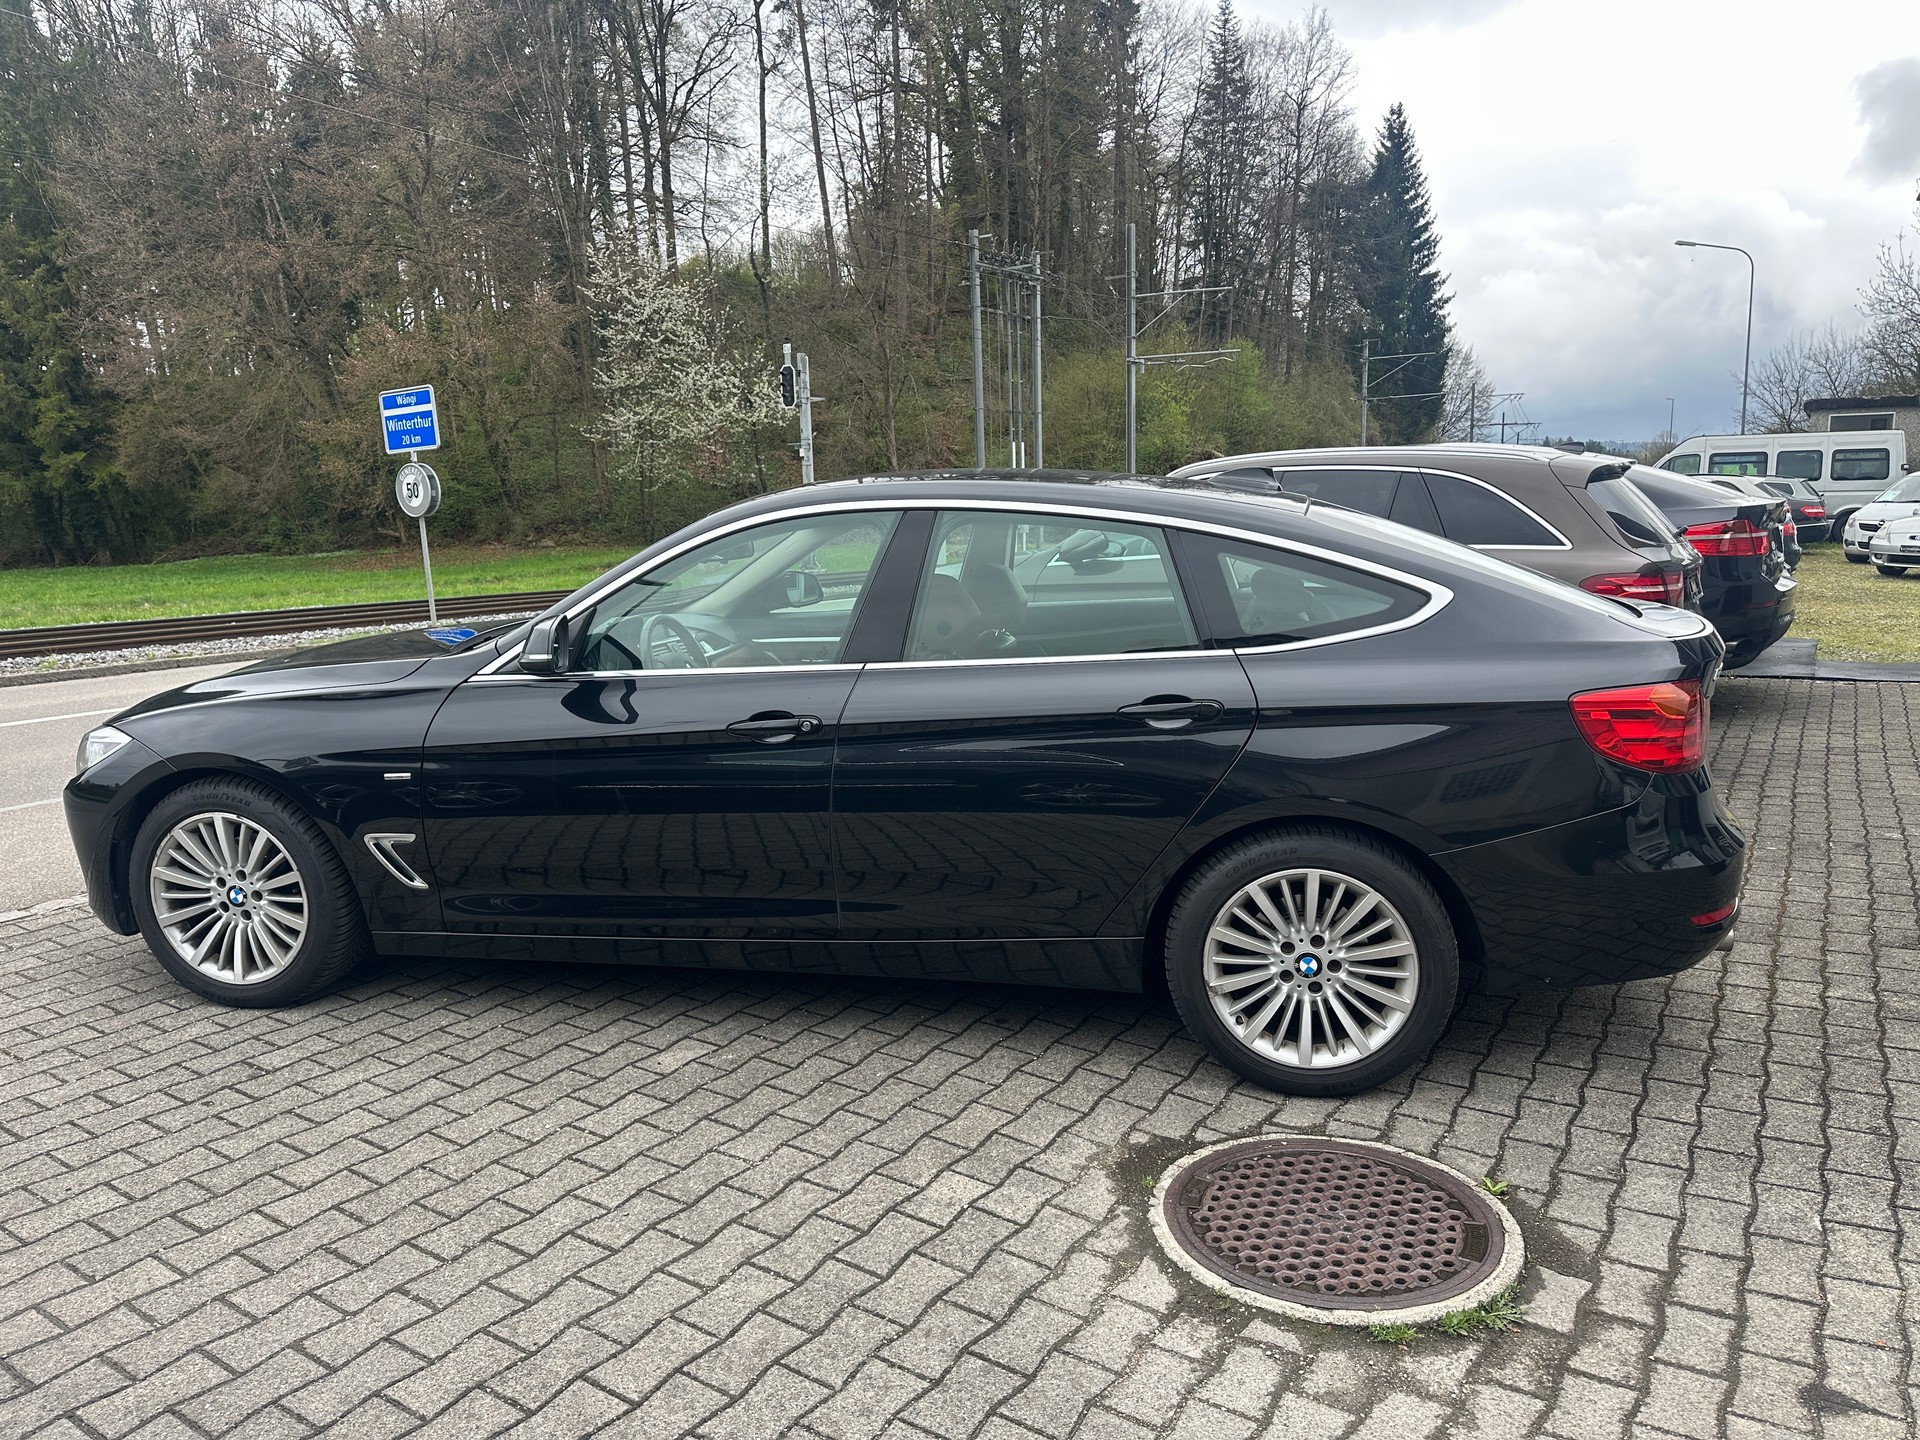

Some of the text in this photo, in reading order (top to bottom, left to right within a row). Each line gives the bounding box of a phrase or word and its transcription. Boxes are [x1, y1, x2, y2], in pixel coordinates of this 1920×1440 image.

[396, 394, 417, 405] Wängi
[387, 415, 432, 432] Winterthur
[401, 434, 422, 445] 20 km
[399, 466, 423, 481] GENERELL
[406, 482, 419, 499] 50
[192, 792, 252, 807] GOODYEAR
[1225, 847, 1298, 879] GOODYEAR
